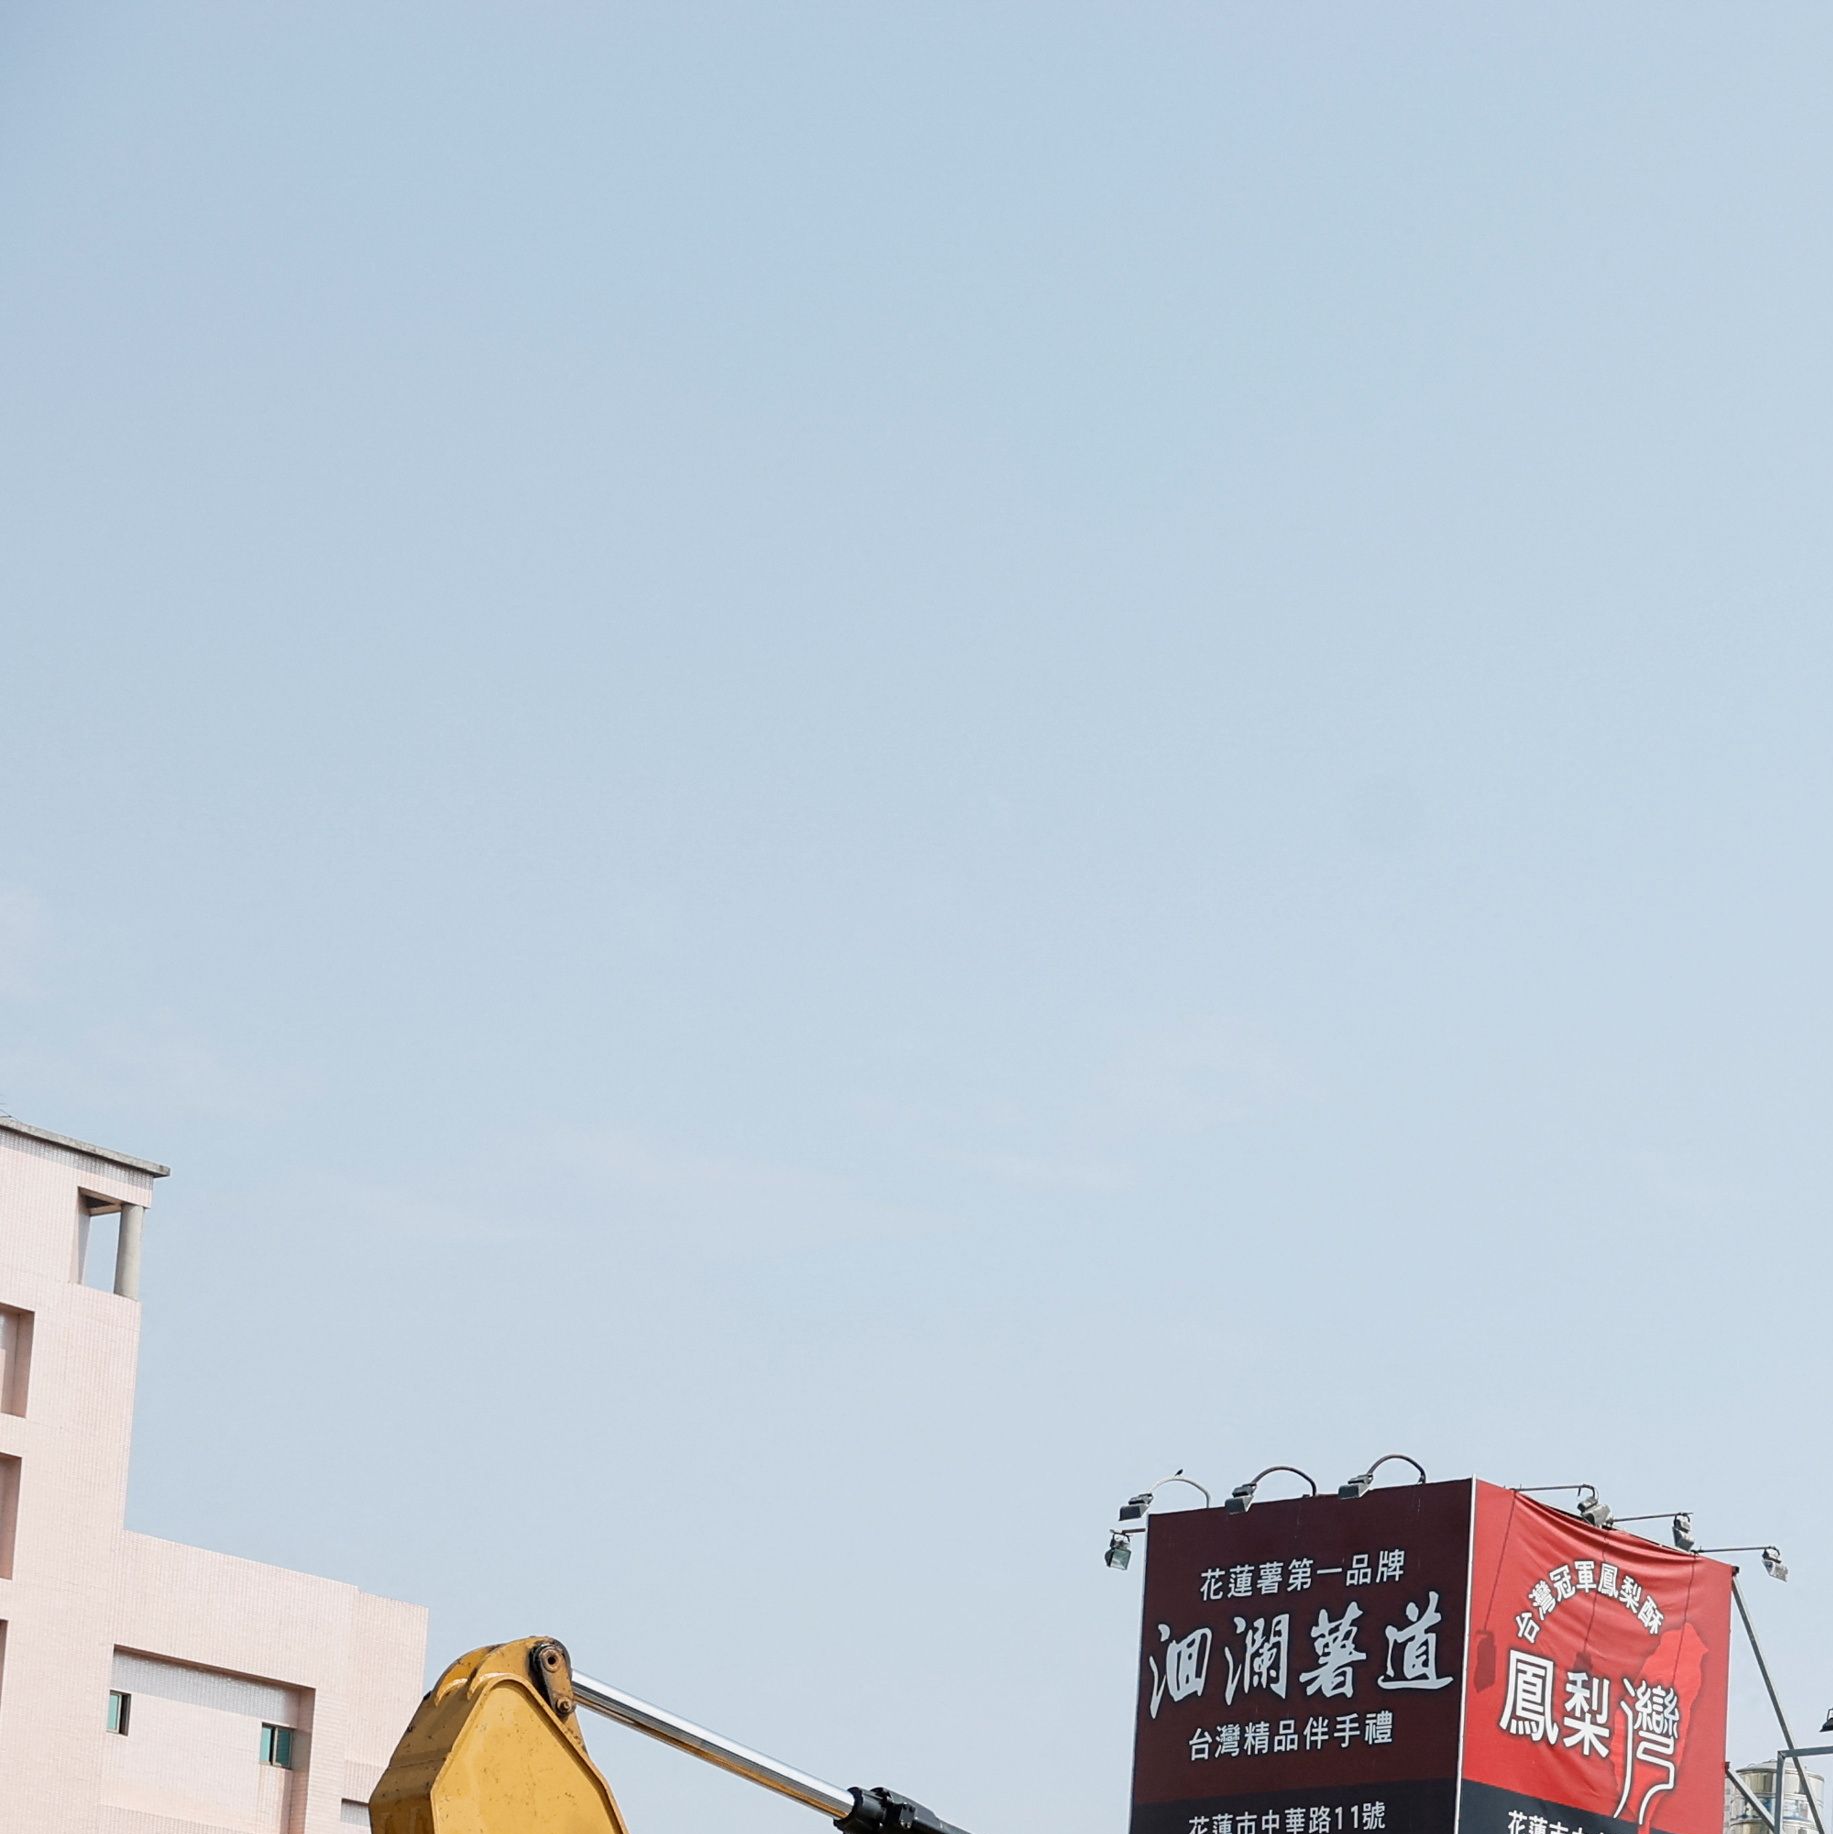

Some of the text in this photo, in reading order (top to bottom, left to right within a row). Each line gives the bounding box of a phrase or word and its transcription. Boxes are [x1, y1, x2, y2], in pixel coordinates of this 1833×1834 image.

[1201, 1548, 1405, 1601] 花蓮薯第一品牌
[1514, 1560, 1663, 1644] 台灣冠軍鳳梨酥
[1188, 1710, 1394, 1761] 台灣精品伴手禮
[1500, 1650, 1679, 1826] 鳳梨灣
